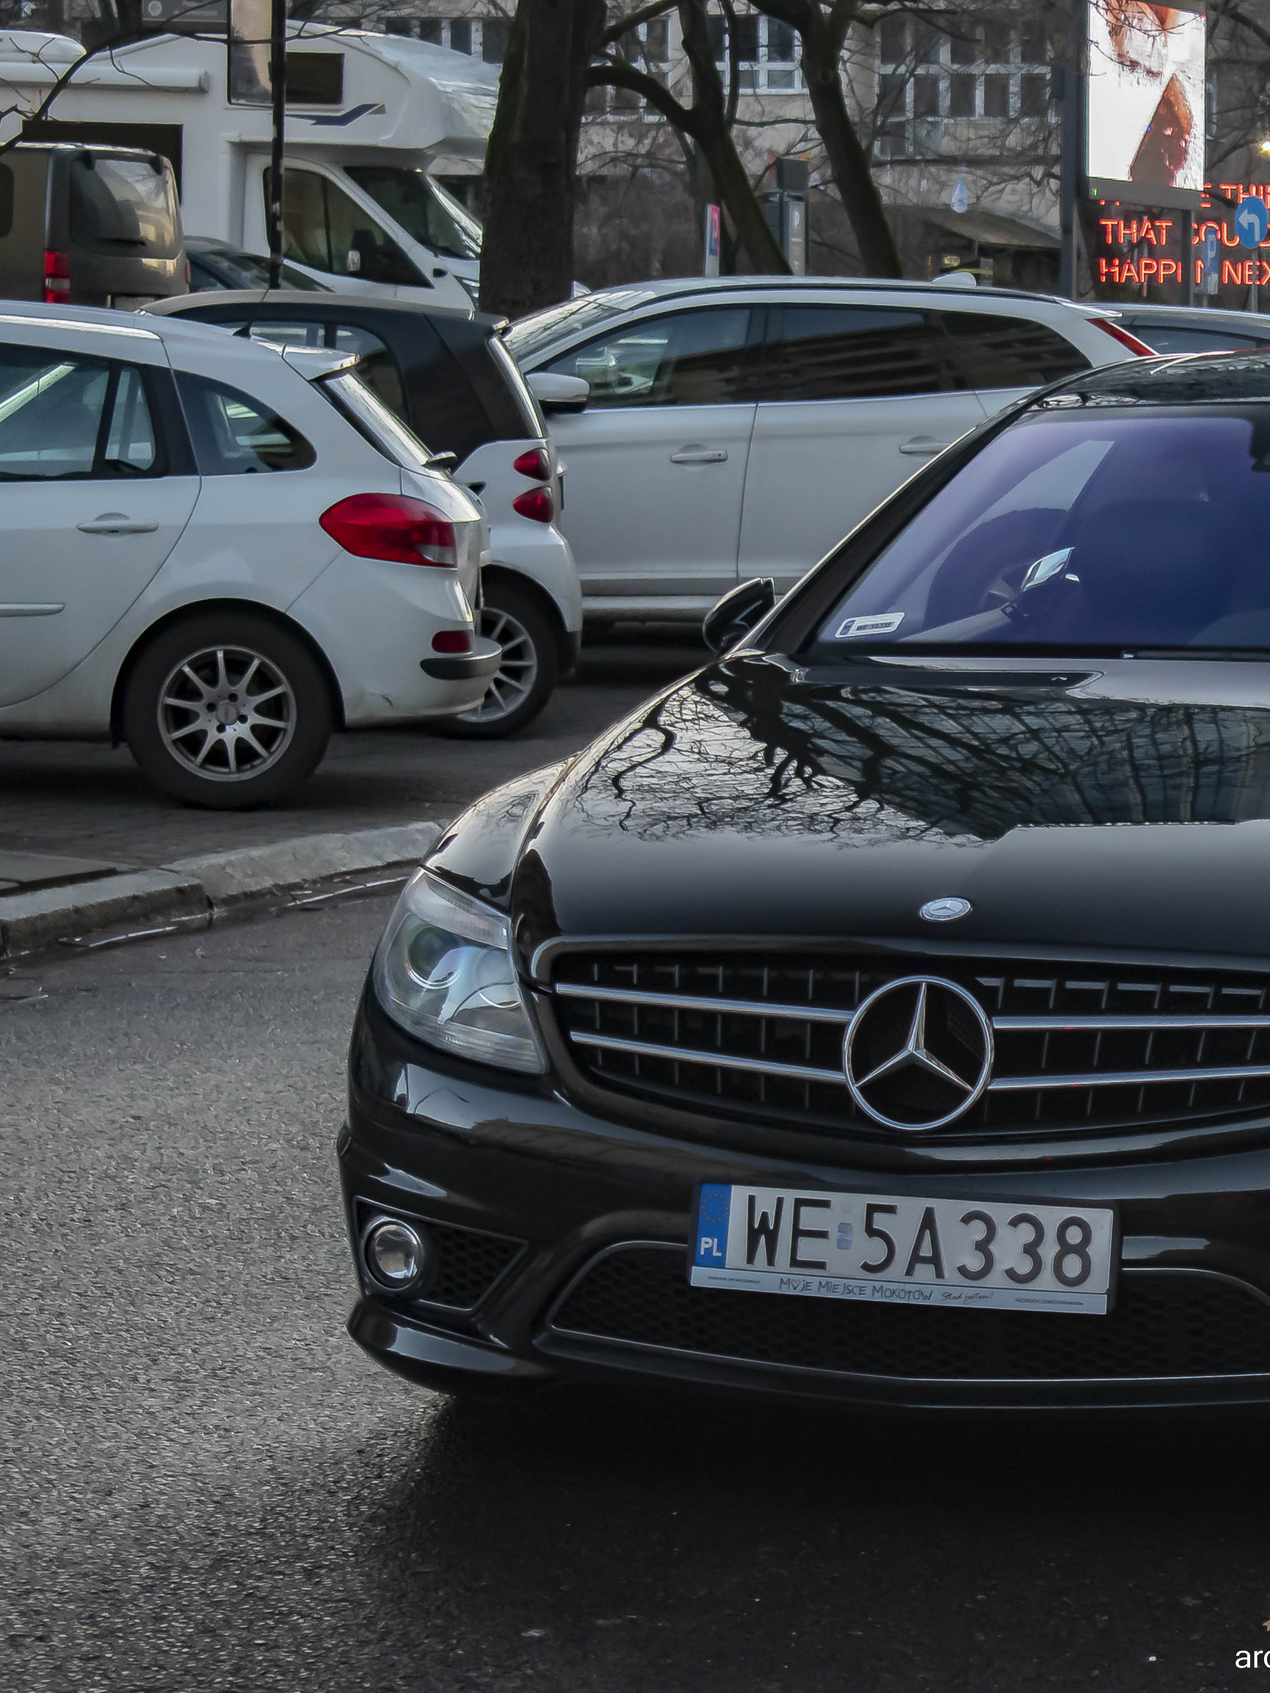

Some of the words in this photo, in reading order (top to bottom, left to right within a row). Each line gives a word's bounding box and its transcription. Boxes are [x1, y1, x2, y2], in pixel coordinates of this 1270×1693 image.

[1099, 219, 1173, 245] THAT
[700, 1237, 722, 1257] PL
[745, 1193, 832, 1270] WE
[859, 1202, 1093, 1287] 5A338
